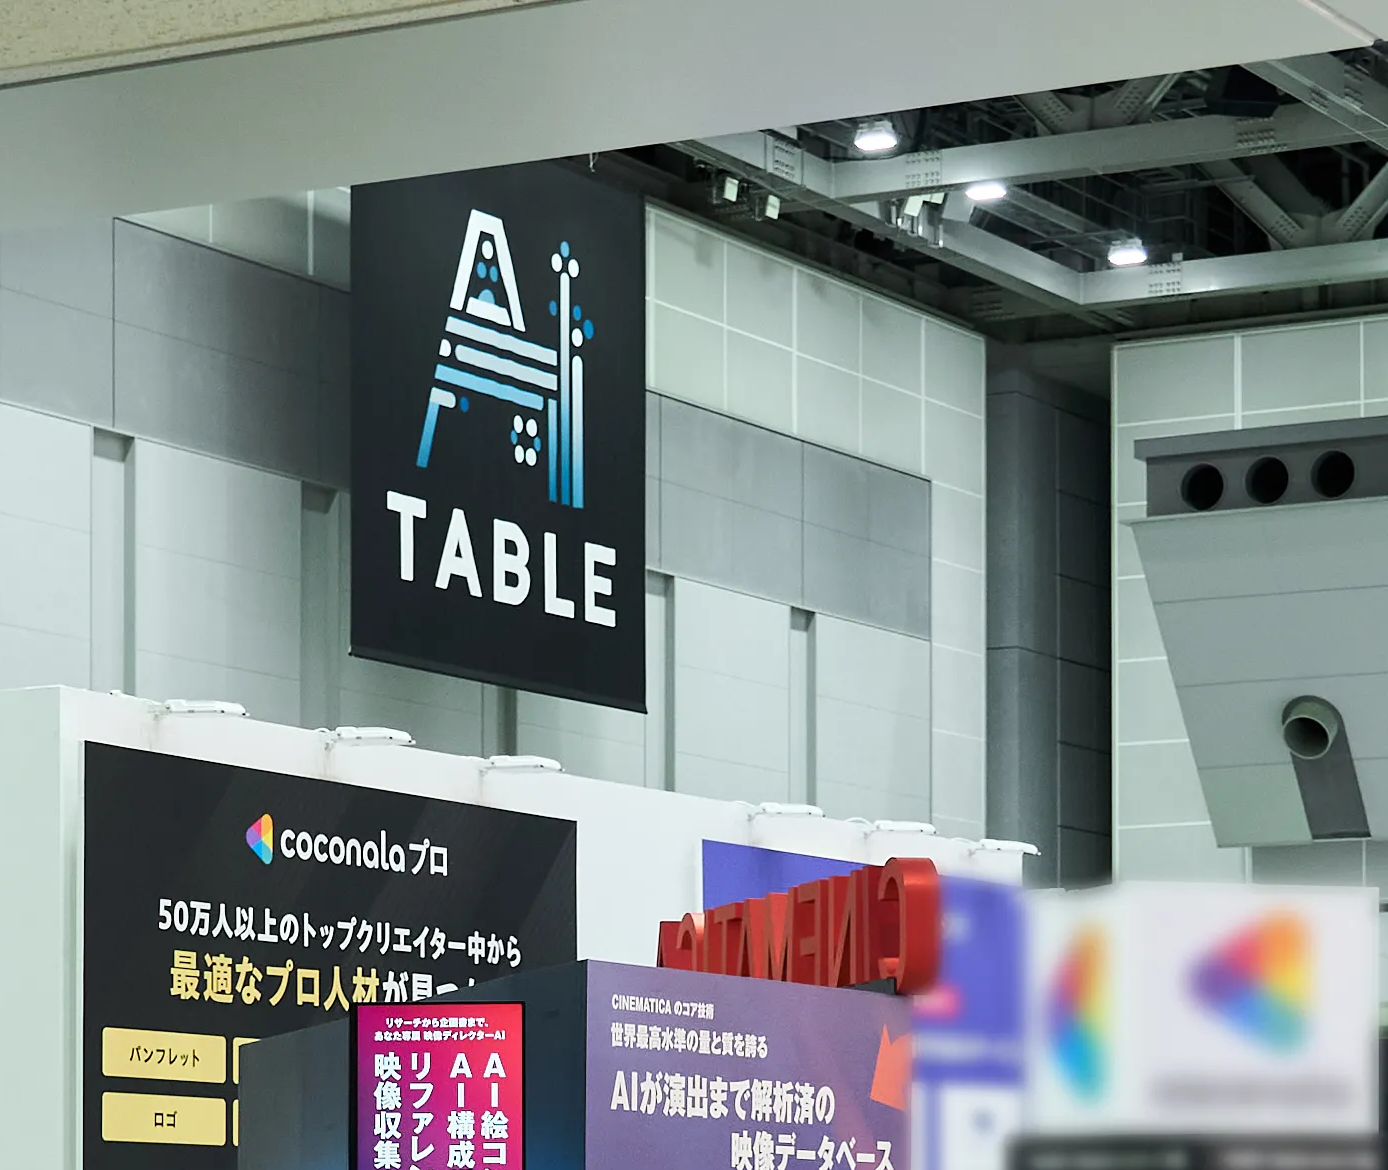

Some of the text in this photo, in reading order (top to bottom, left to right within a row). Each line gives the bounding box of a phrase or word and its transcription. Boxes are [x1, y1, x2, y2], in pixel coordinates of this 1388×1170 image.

[386, 490, 616, 627] TABLE
[158, 898, 522, 968] 50万人以上のトップクリエイター中から
[612, 994, 715, 1020] CINEMATICA のコア技術
[129, 1045, 200, 1068] パンフレット
[611, 1022, 768, 1059] 世界最高水準の量と質を誇る
[154, 1110, 177, 1128] ロゴ
[373, 1052, 402, 1170] 映像収集
[610, 1070, 836, 1125] AIが演出まで解析済の
